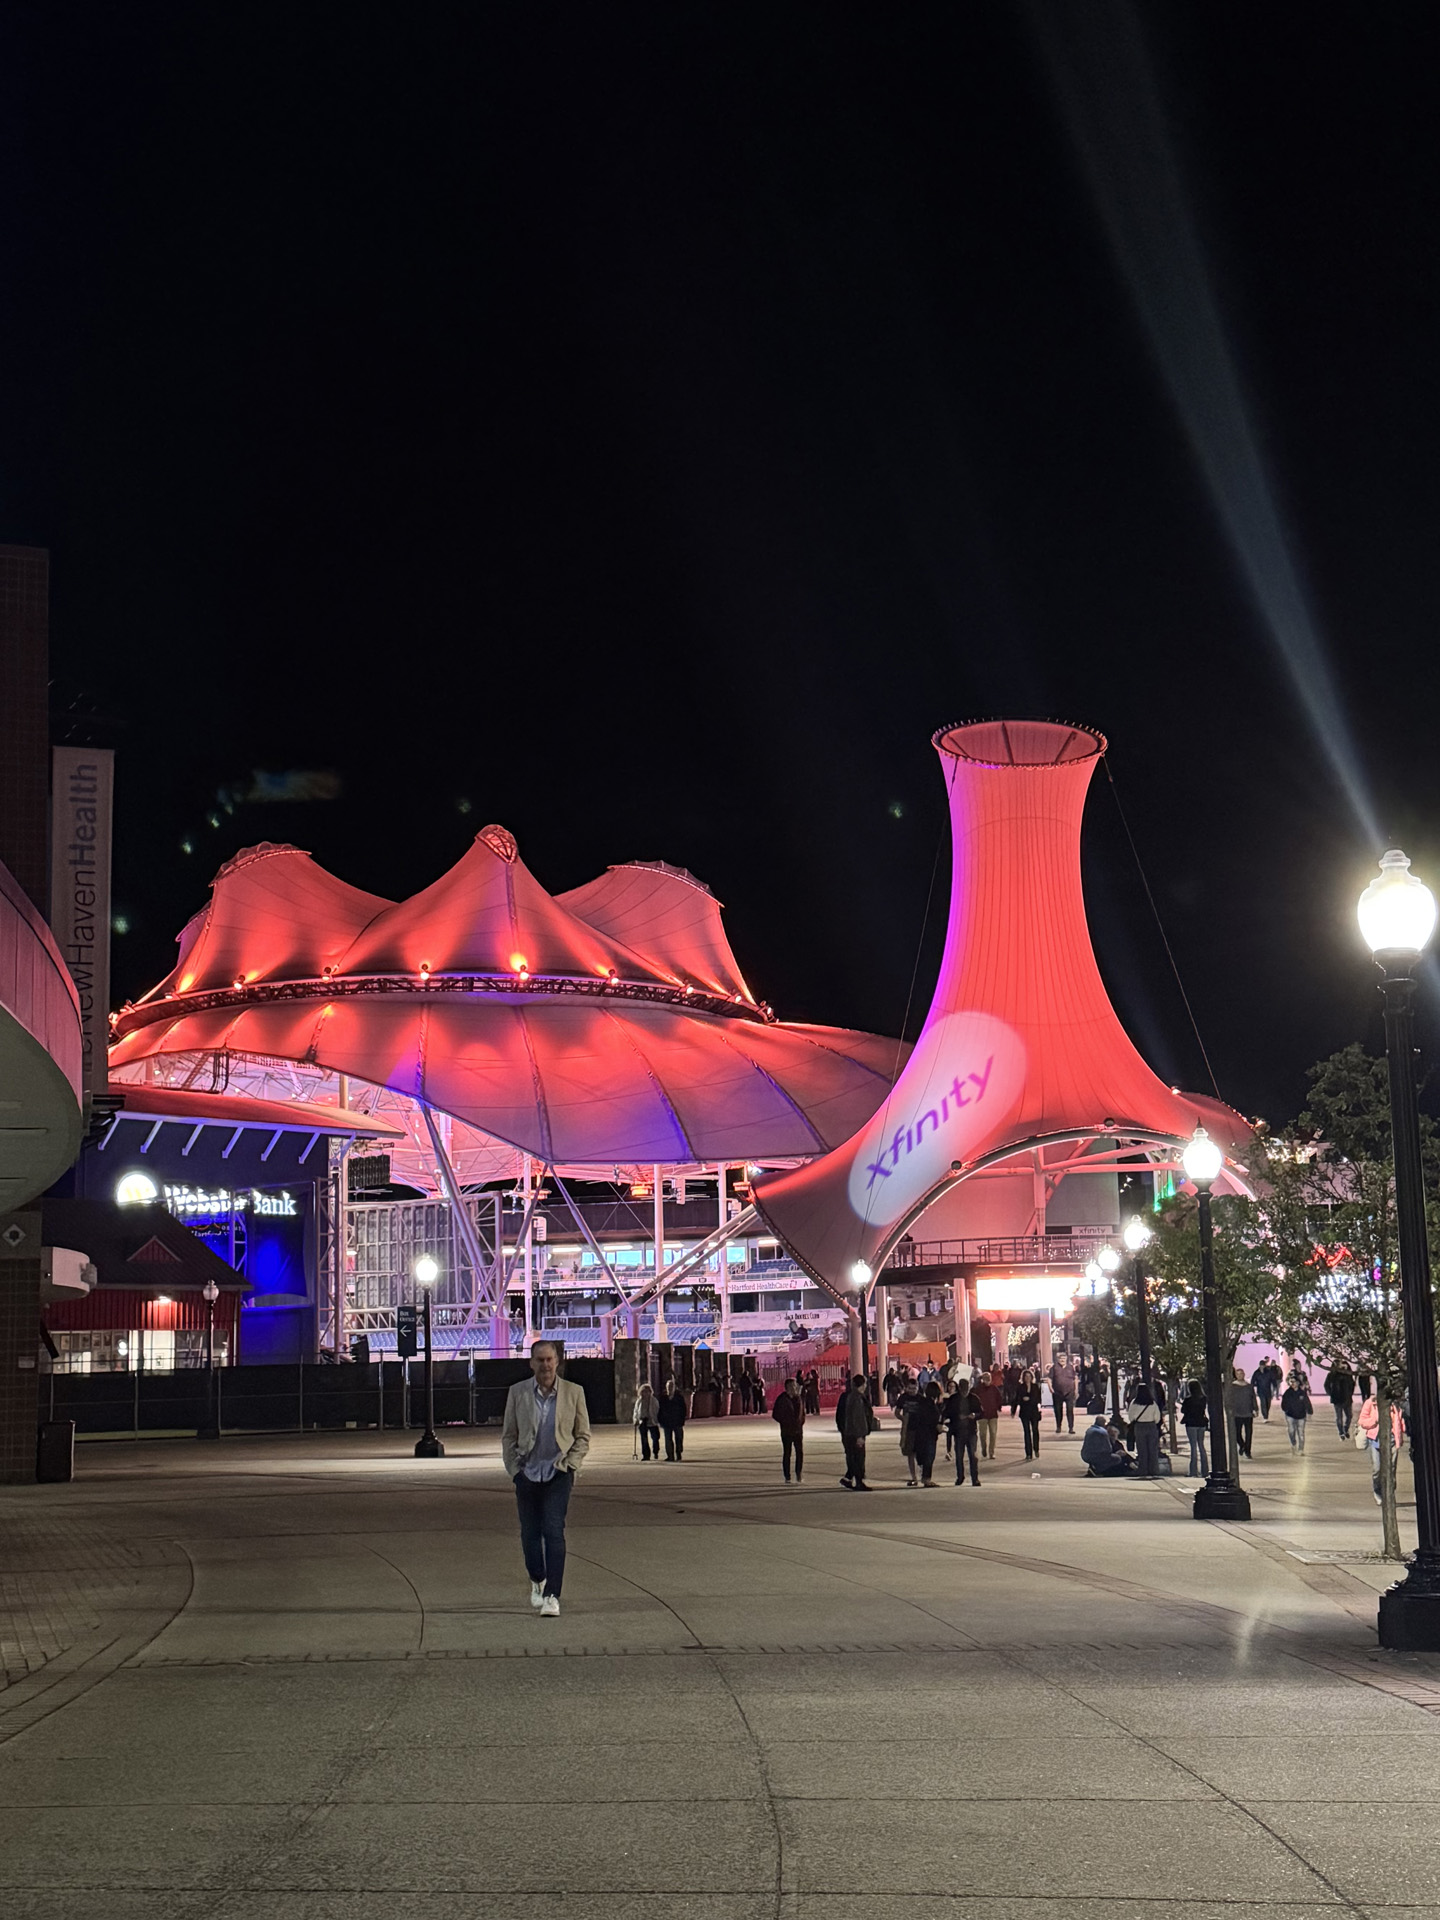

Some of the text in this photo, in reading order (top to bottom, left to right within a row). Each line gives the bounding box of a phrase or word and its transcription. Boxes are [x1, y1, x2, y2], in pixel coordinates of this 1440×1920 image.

[866, 1055, 995, 1191] xfinity
[1079, 1227, 1106, 1235] xfinity
[731, 1281, 789, 1292] Hartford HealthCare
